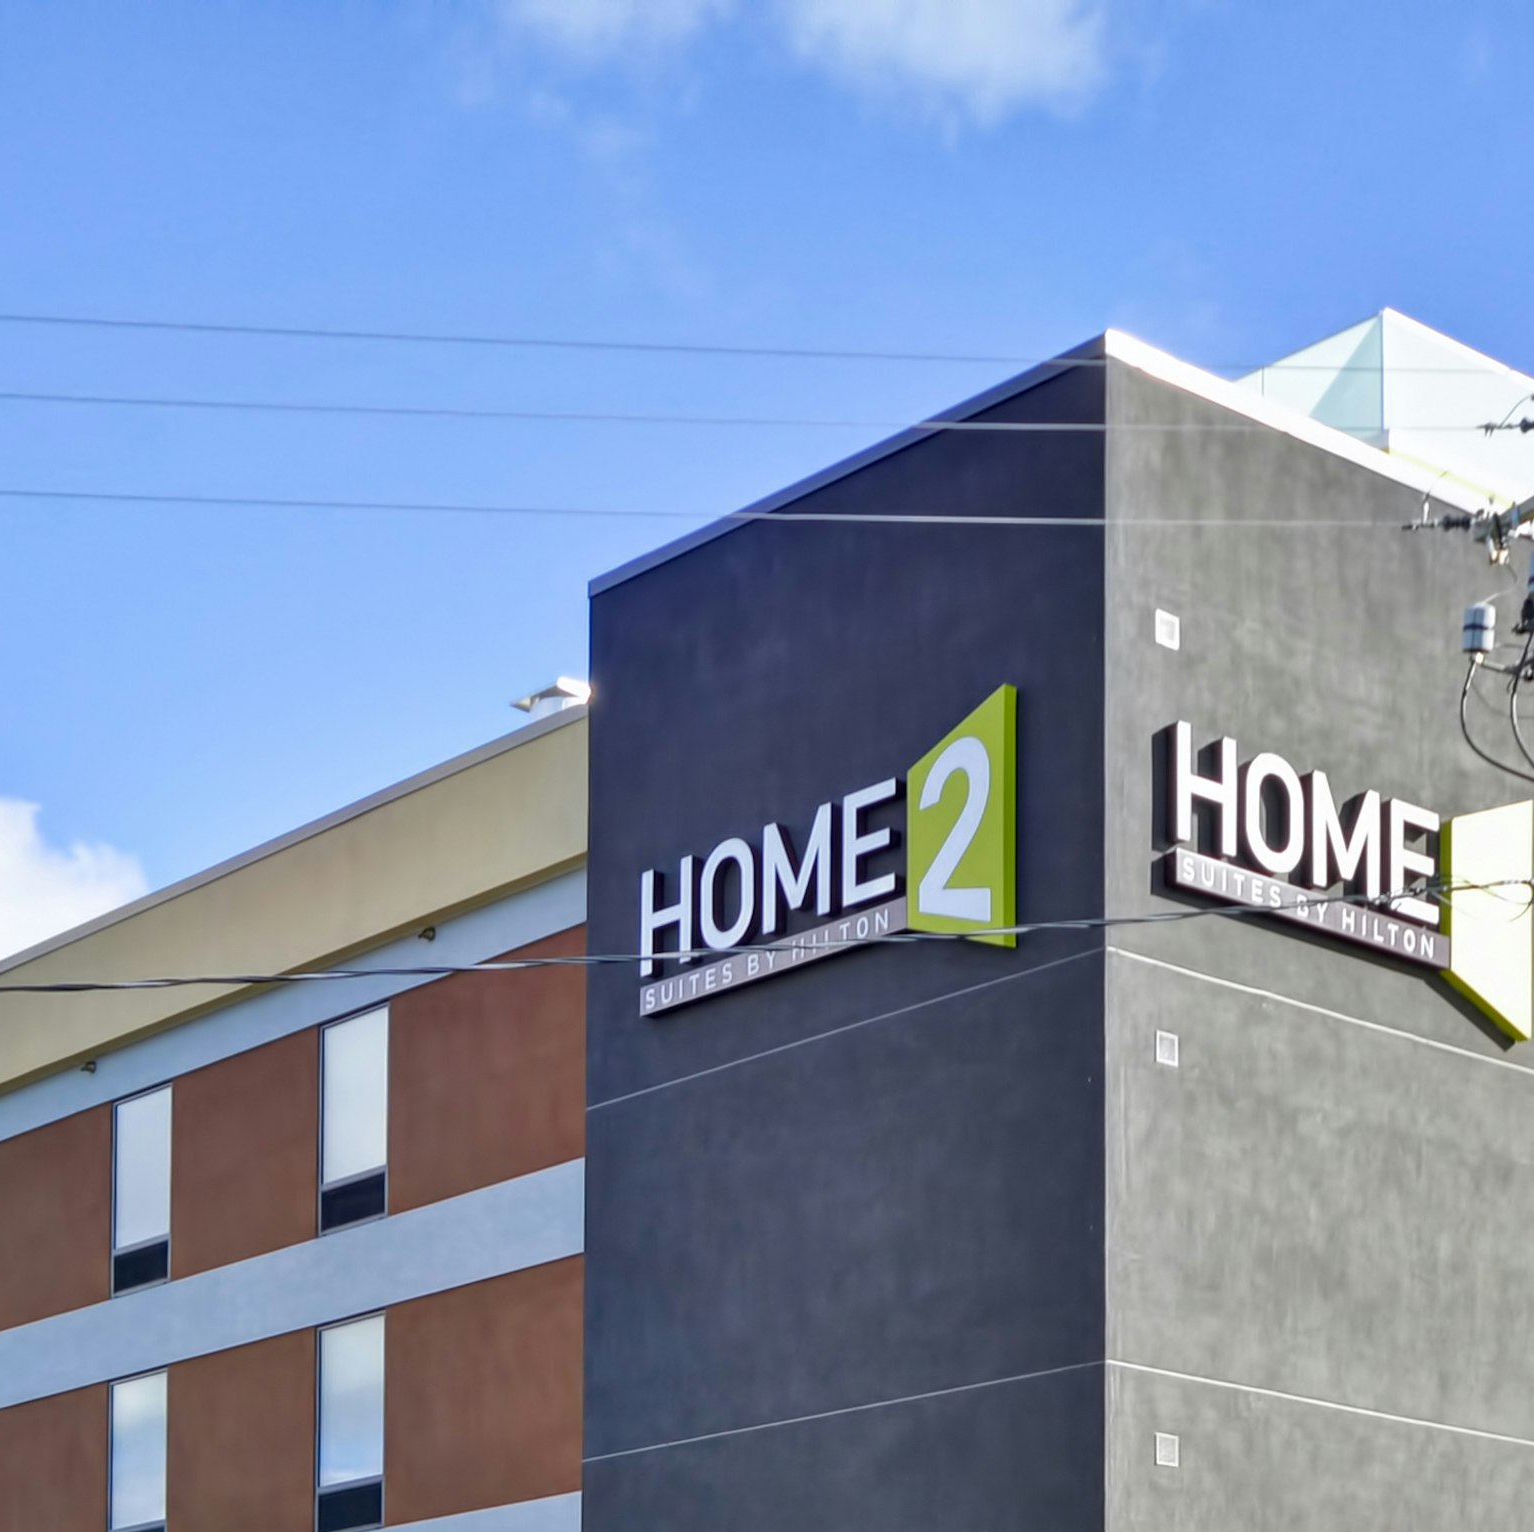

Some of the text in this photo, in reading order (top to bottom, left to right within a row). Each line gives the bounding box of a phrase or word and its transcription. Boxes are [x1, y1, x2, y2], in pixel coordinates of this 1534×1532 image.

[1176, 720, 1440, 925] HOME
[1183, 857, 1434, 959] SUITES BY HILTON
[645, 962, 733, 1010] SUITES
[747, 951, 776, 976] BY
